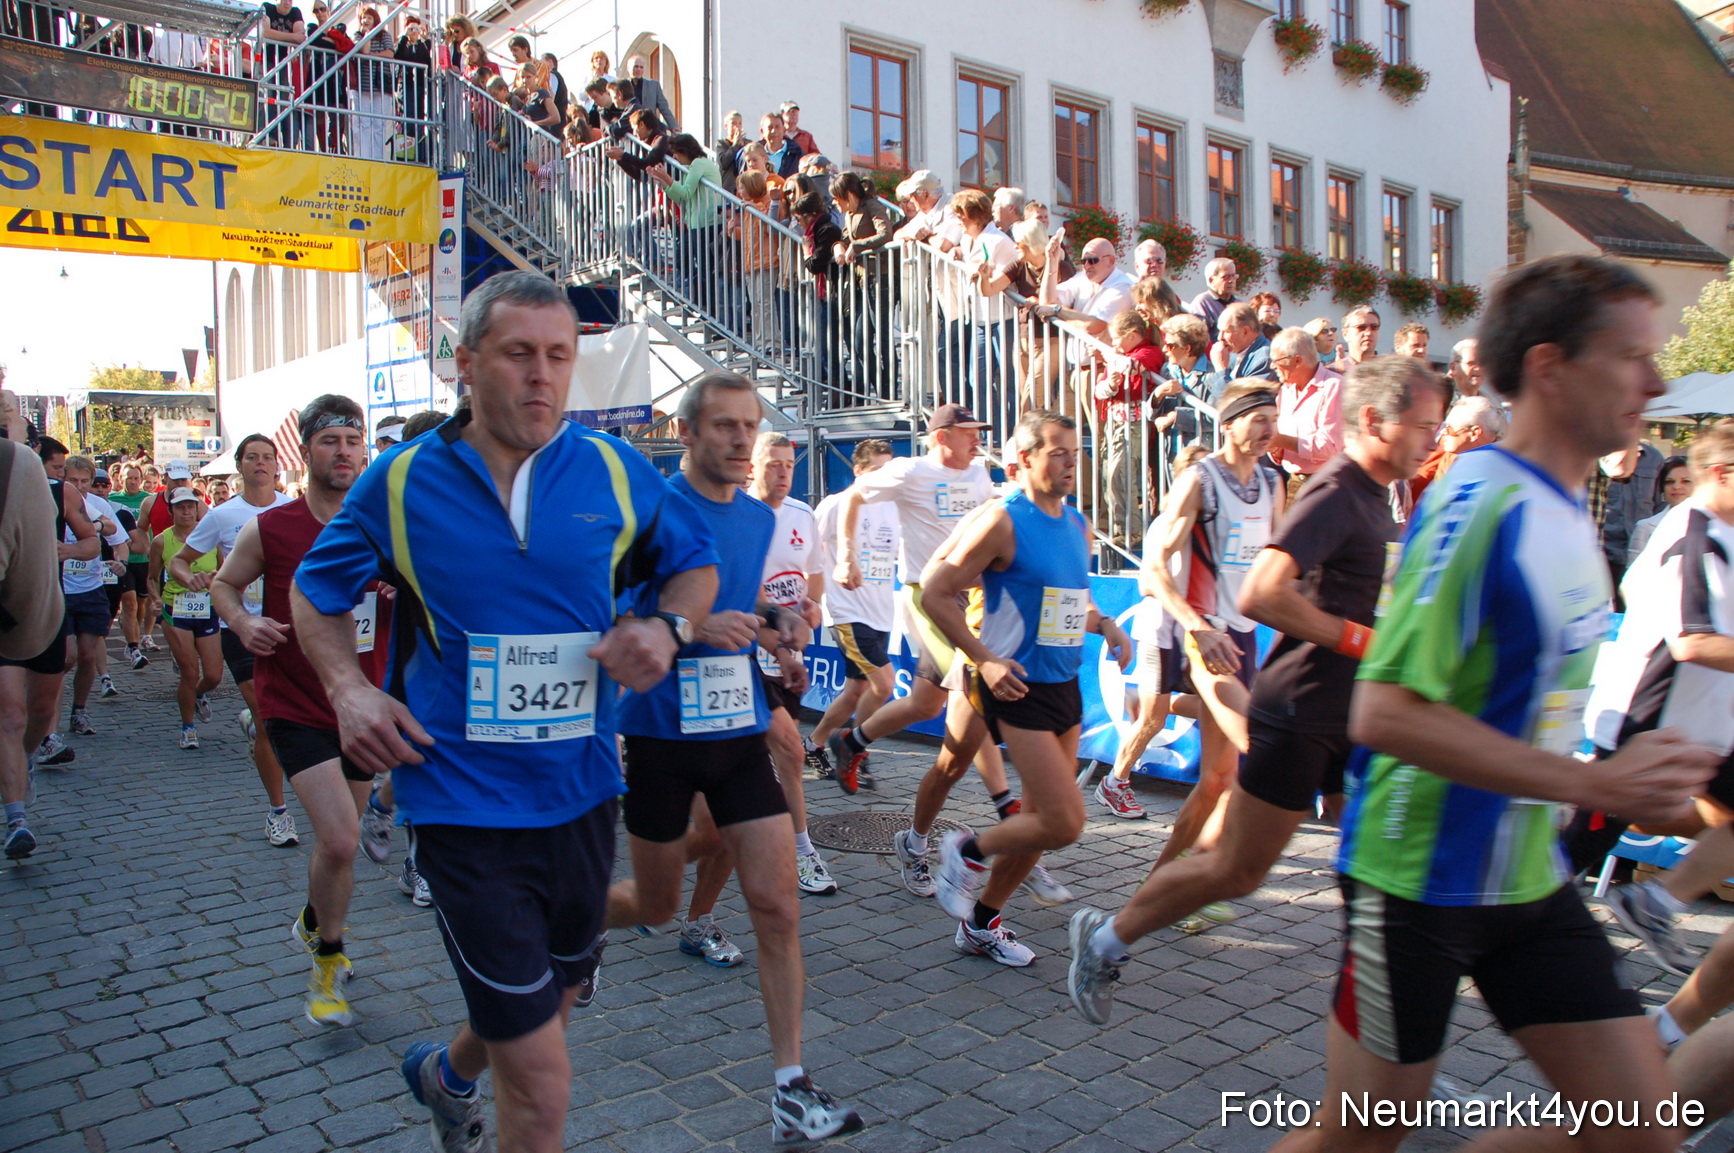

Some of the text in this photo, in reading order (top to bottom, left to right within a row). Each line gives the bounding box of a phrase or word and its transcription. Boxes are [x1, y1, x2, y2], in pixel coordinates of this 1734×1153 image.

[86, 57, 248, 92] Elektronische Sportstätteneinrichtungen
[0, 135, 239, 210] START
[279, 196, 406, 218] Neumarkter Stadtlauf
[287, 238, 334, 251] Stadtlauf
[70, 561, 86, 569] 109
[871, 567, 892, 577] 2112
[187, 602, 204, 611] 928
[506, 645, 558, 665] Alfred
[703, 665, 736, 678] Alfons
[474, 676, 482, 691] A
[508, 680, 587, 712] 3427
[707, 687, 749, 710] 2736
